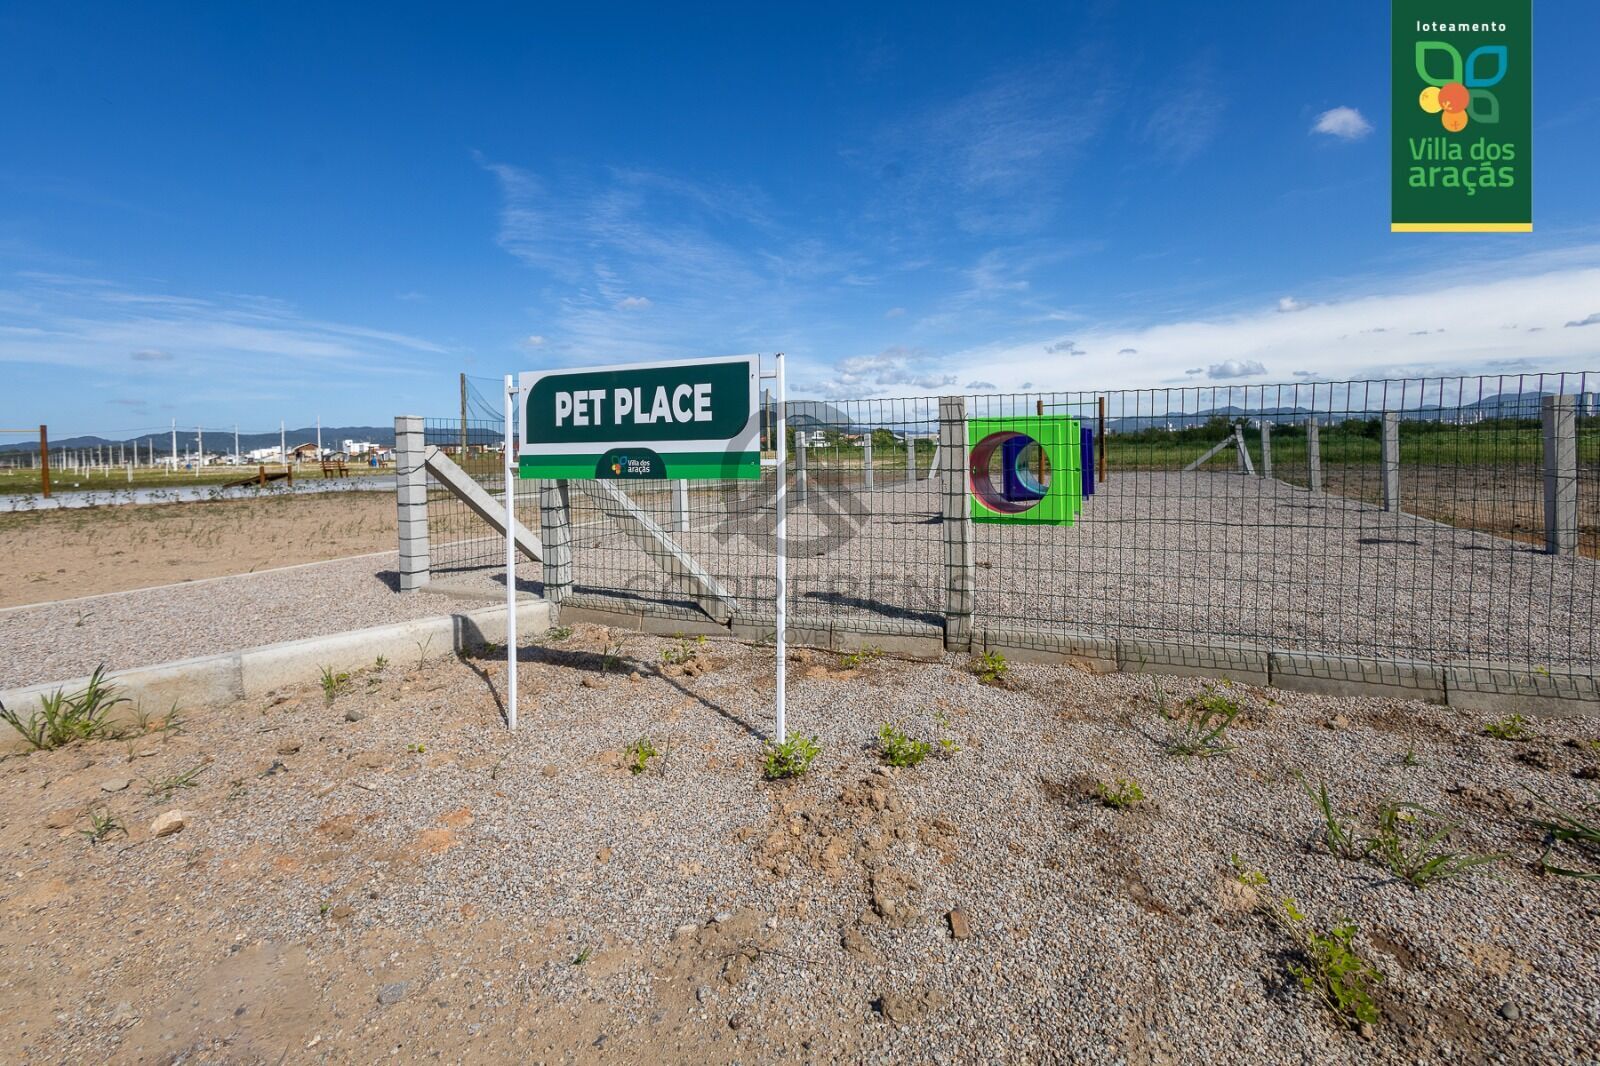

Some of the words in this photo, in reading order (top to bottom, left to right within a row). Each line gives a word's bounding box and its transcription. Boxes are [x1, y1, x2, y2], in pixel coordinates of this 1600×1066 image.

[555, 389, 606, 427] PET
[614, 383, 713, 425] PLACE
[627, 459, 639, 467] Villa
